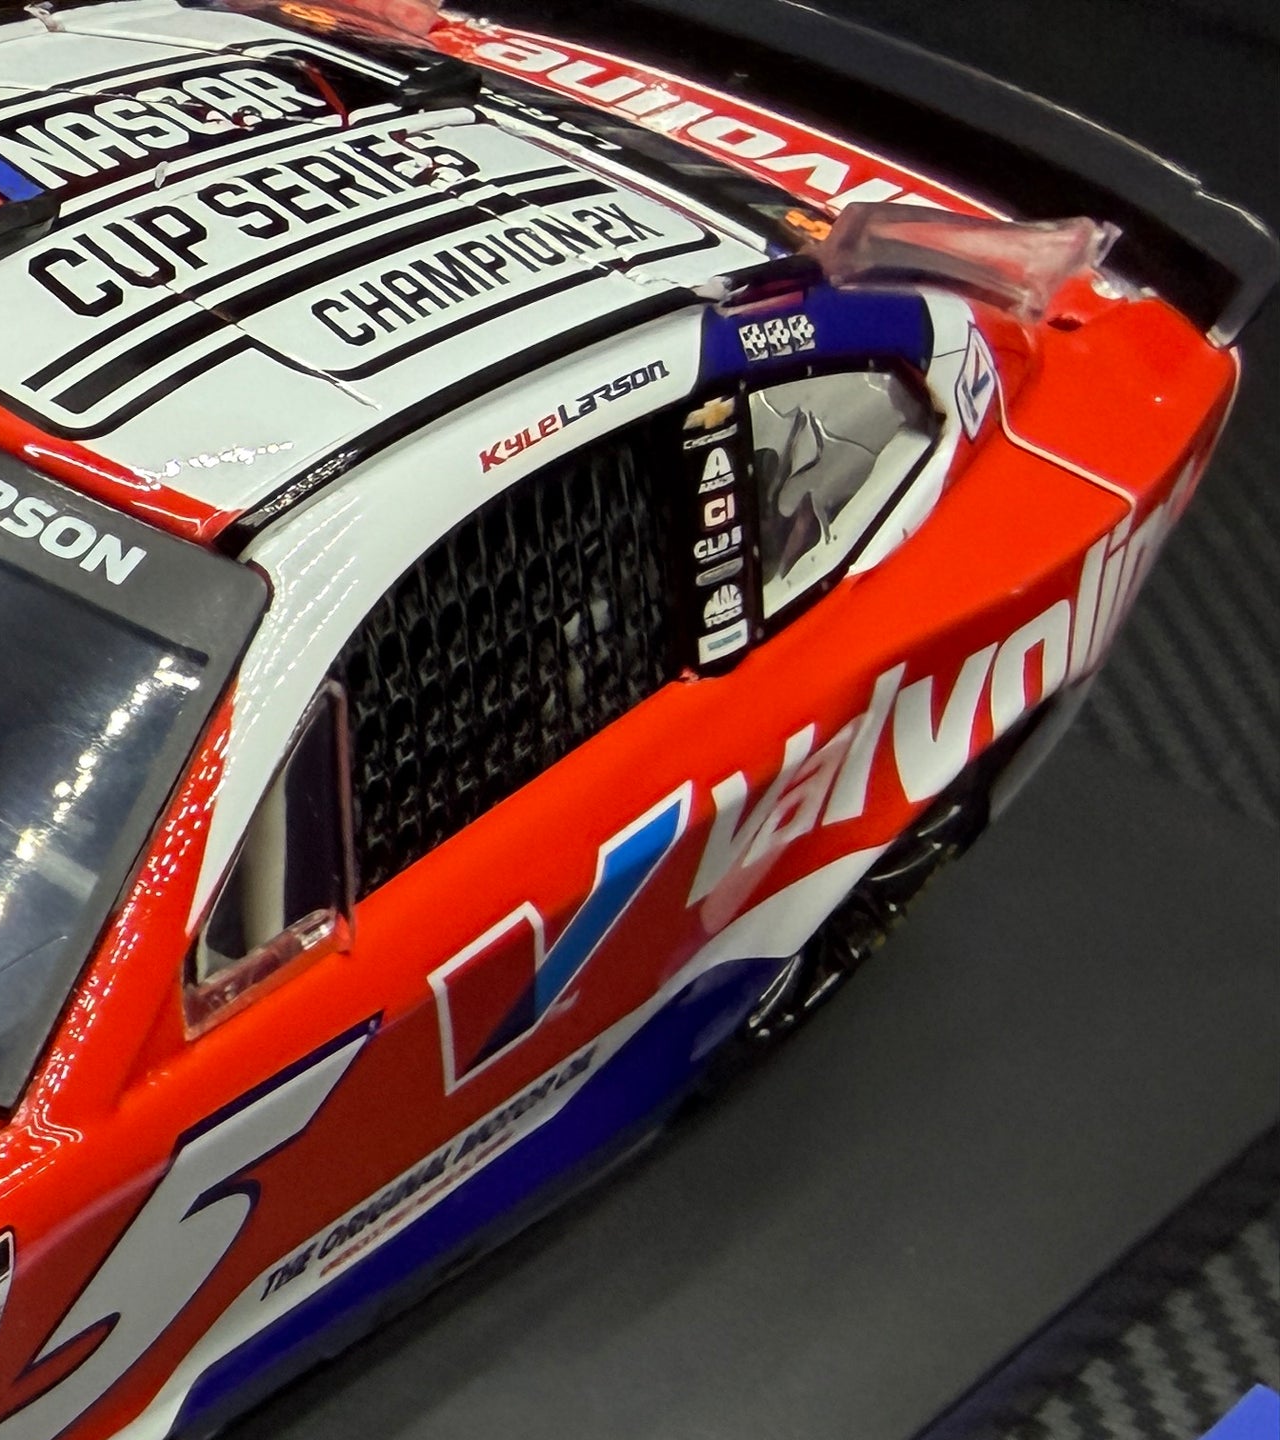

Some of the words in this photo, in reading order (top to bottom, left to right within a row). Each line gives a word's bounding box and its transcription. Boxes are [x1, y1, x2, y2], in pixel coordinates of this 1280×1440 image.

[28, 204, 209, 318] CUP
[194, 129, 481, 241] SERIES
[311, 214, 602, 347] CHAMPION
[571, 203, 665, 256] 2X
